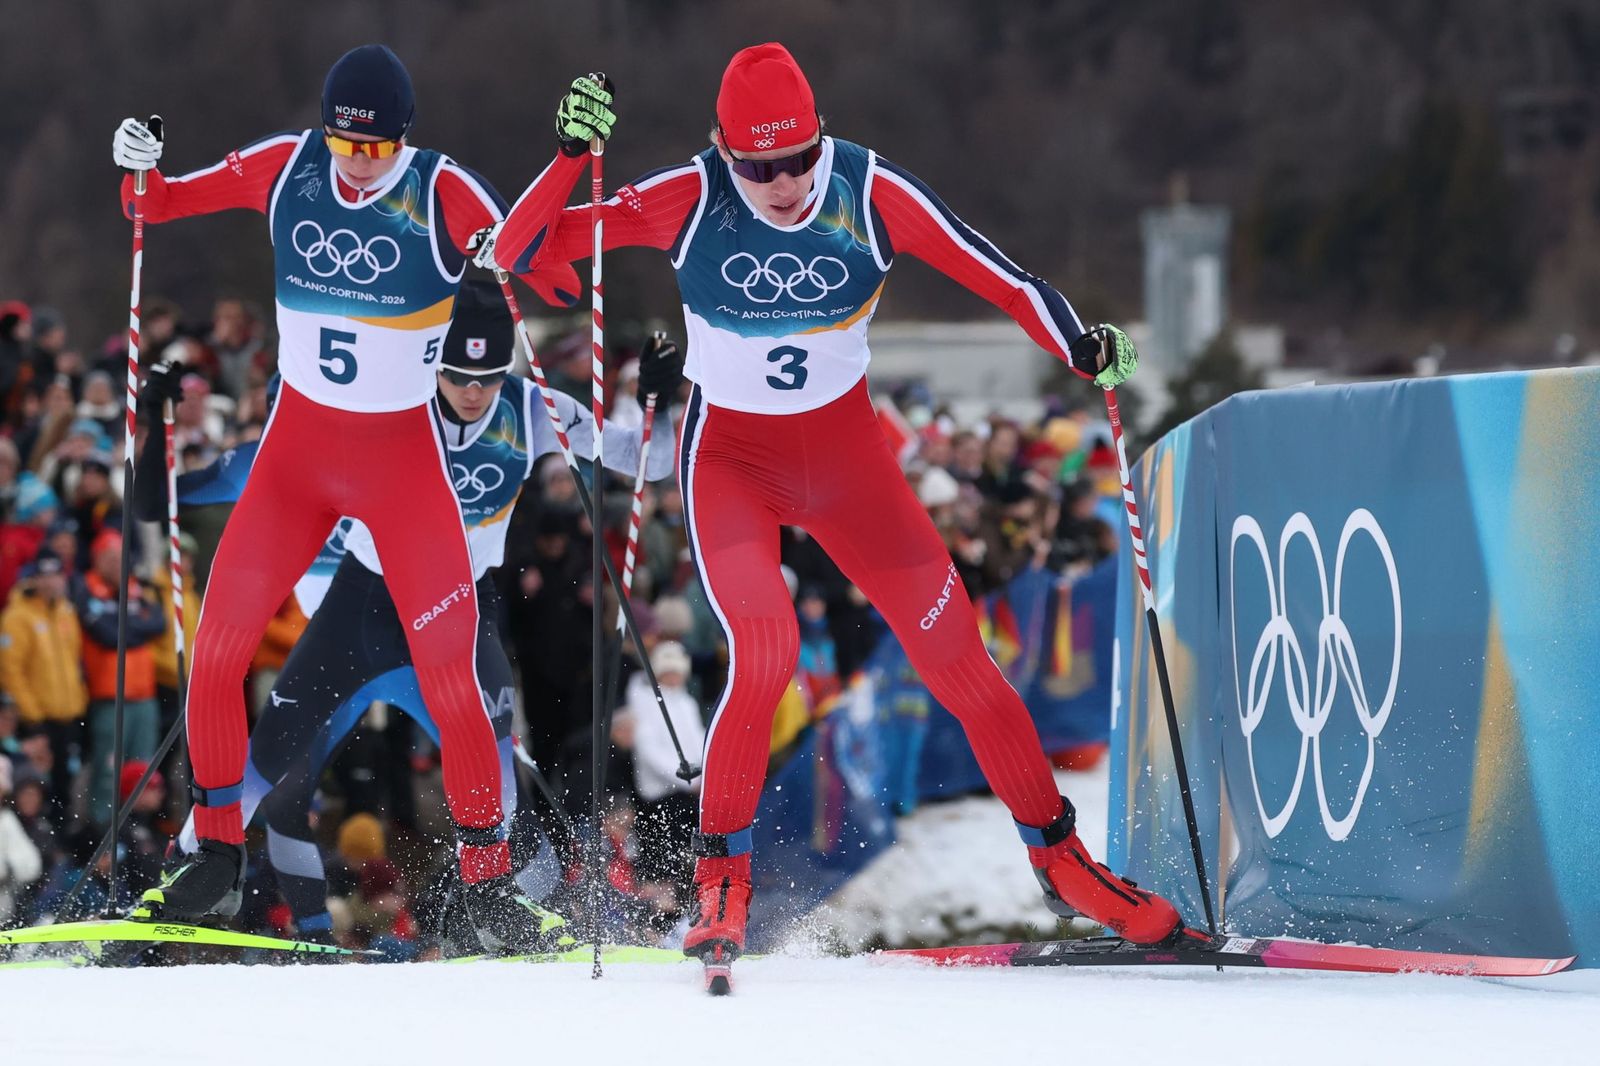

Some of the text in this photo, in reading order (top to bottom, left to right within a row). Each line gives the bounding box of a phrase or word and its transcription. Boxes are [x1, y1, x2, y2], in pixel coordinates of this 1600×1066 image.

[335, 105, 376, 120] NORGE
[751, 118, 798, 135] NORGE
[285, 274, 406, 305] MILANO CORTINA 2026
[319, 326, 358, 385] 5
[423, 337, 441, 364] 5
[765, 345, 809, 391] 3
[413, 590, 460, 631] CRAFT
[920, 573, 955, 631] CRAFT
[152, 925, 197, 937] FISCHER
